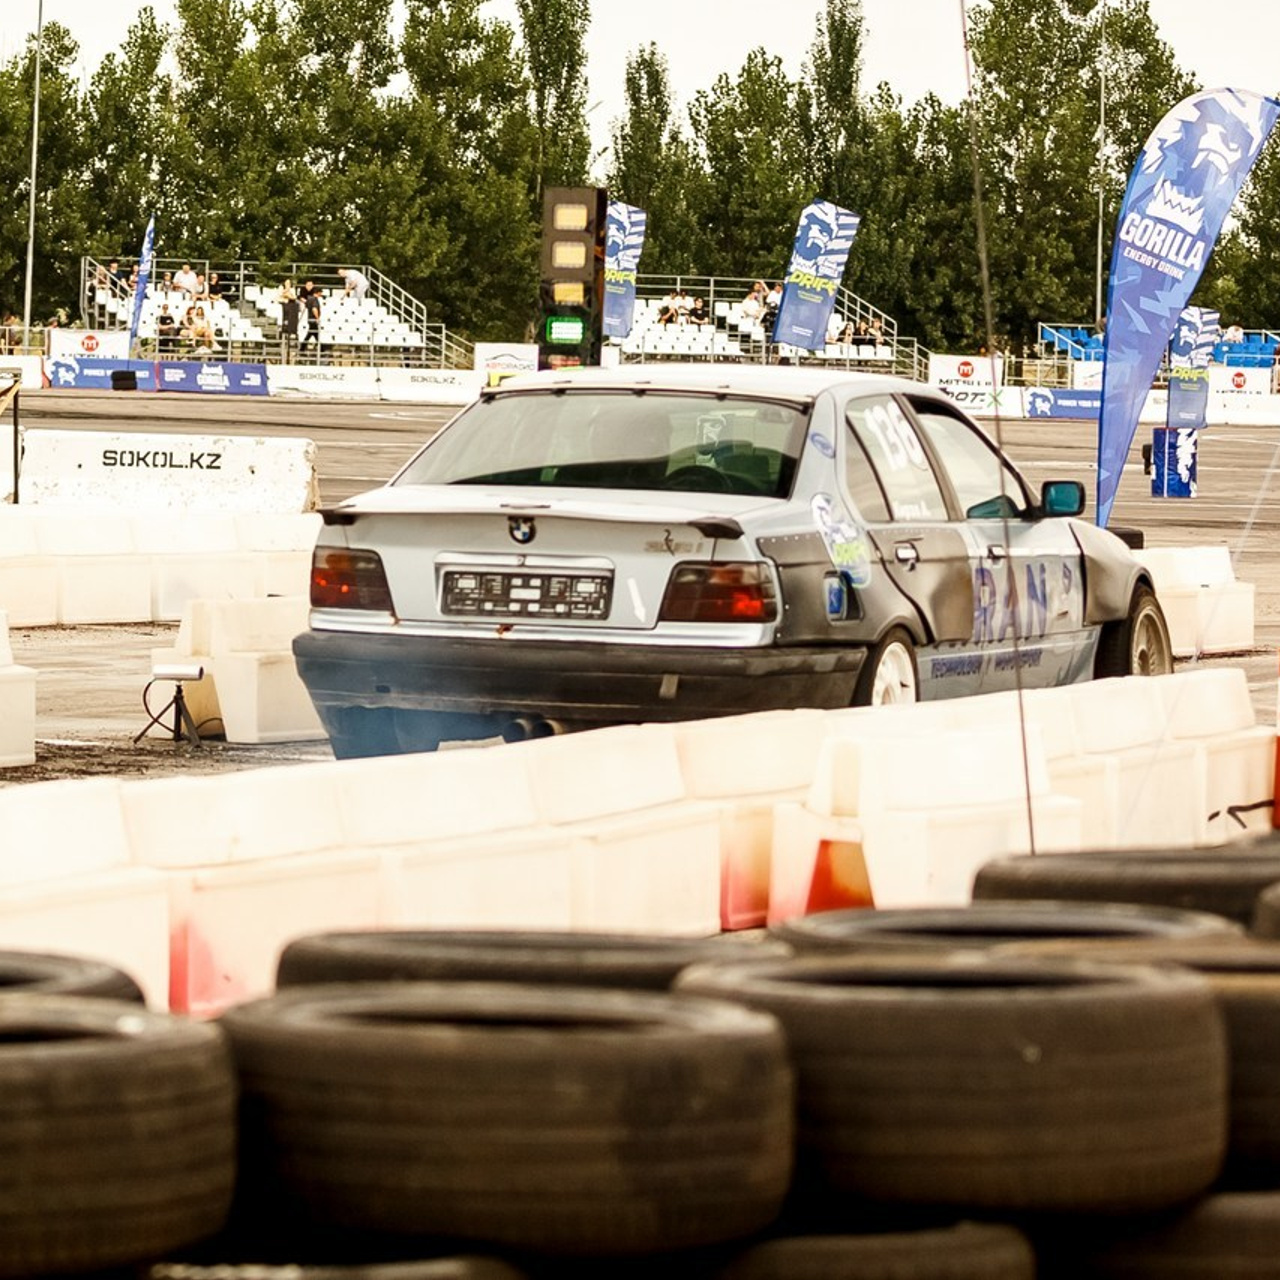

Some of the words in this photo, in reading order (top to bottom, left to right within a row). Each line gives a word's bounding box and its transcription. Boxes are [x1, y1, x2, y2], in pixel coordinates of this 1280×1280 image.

[1119, 212, 1206, 271] GORILLA
[1123, 246, 1161, 269] ENERGY
[1157, 261, 1186, 280] DRINK
[102, 450, 222, 470] SOKOL.KZ
